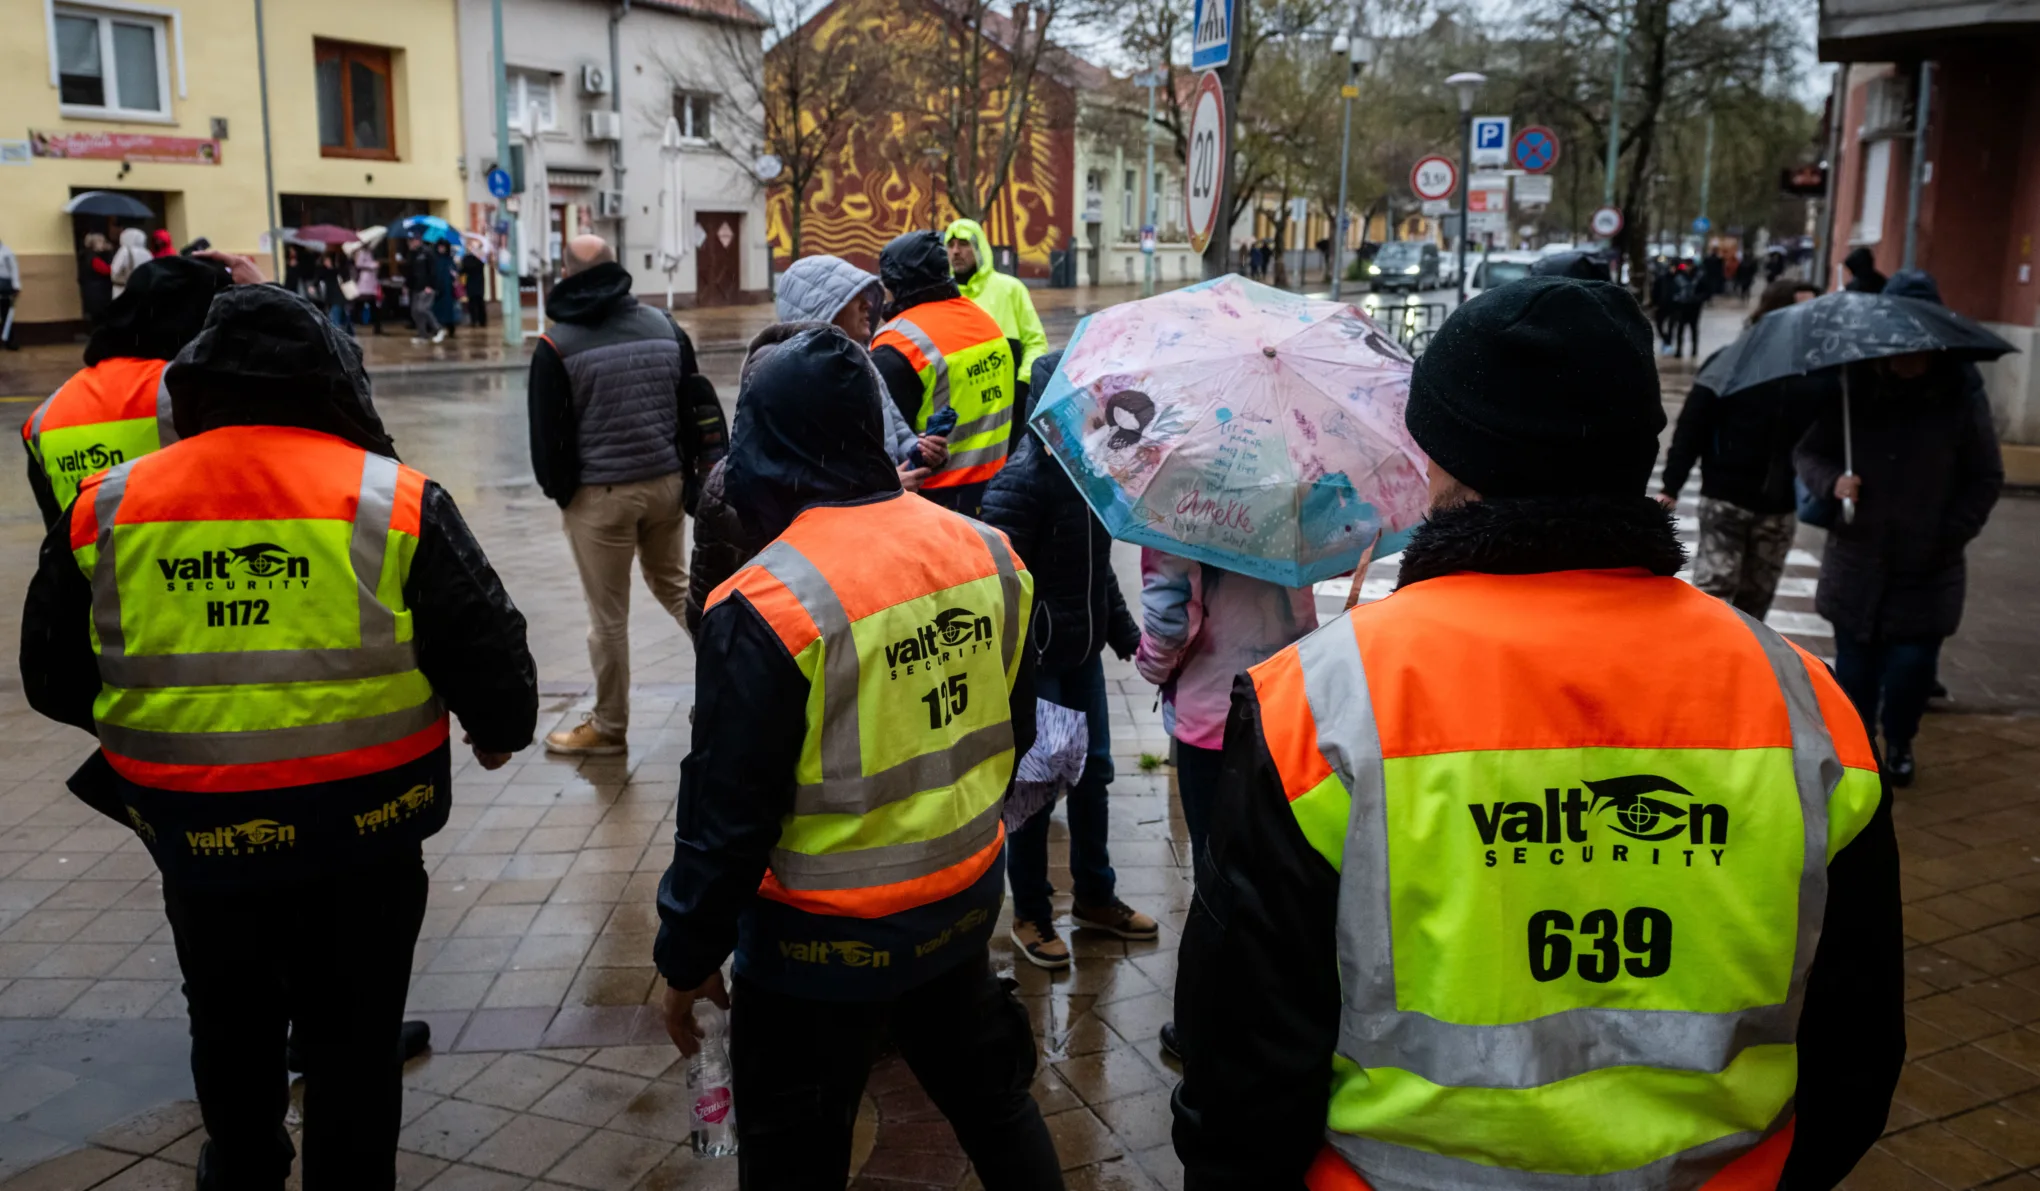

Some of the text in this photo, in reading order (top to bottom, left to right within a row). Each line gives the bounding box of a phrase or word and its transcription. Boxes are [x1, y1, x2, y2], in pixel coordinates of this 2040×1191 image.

[1481, 124, 1499, 147] P
[1193, 130, 1214, 198] 20
[167, 580, 309, 591] SECURITY
[207, 599, 269, 627] H172
[891, 641, 992, 680] SECURITY
[1485, 844, 1725, 868] SECURITY
[1527, 906, 1673, 983] 639
